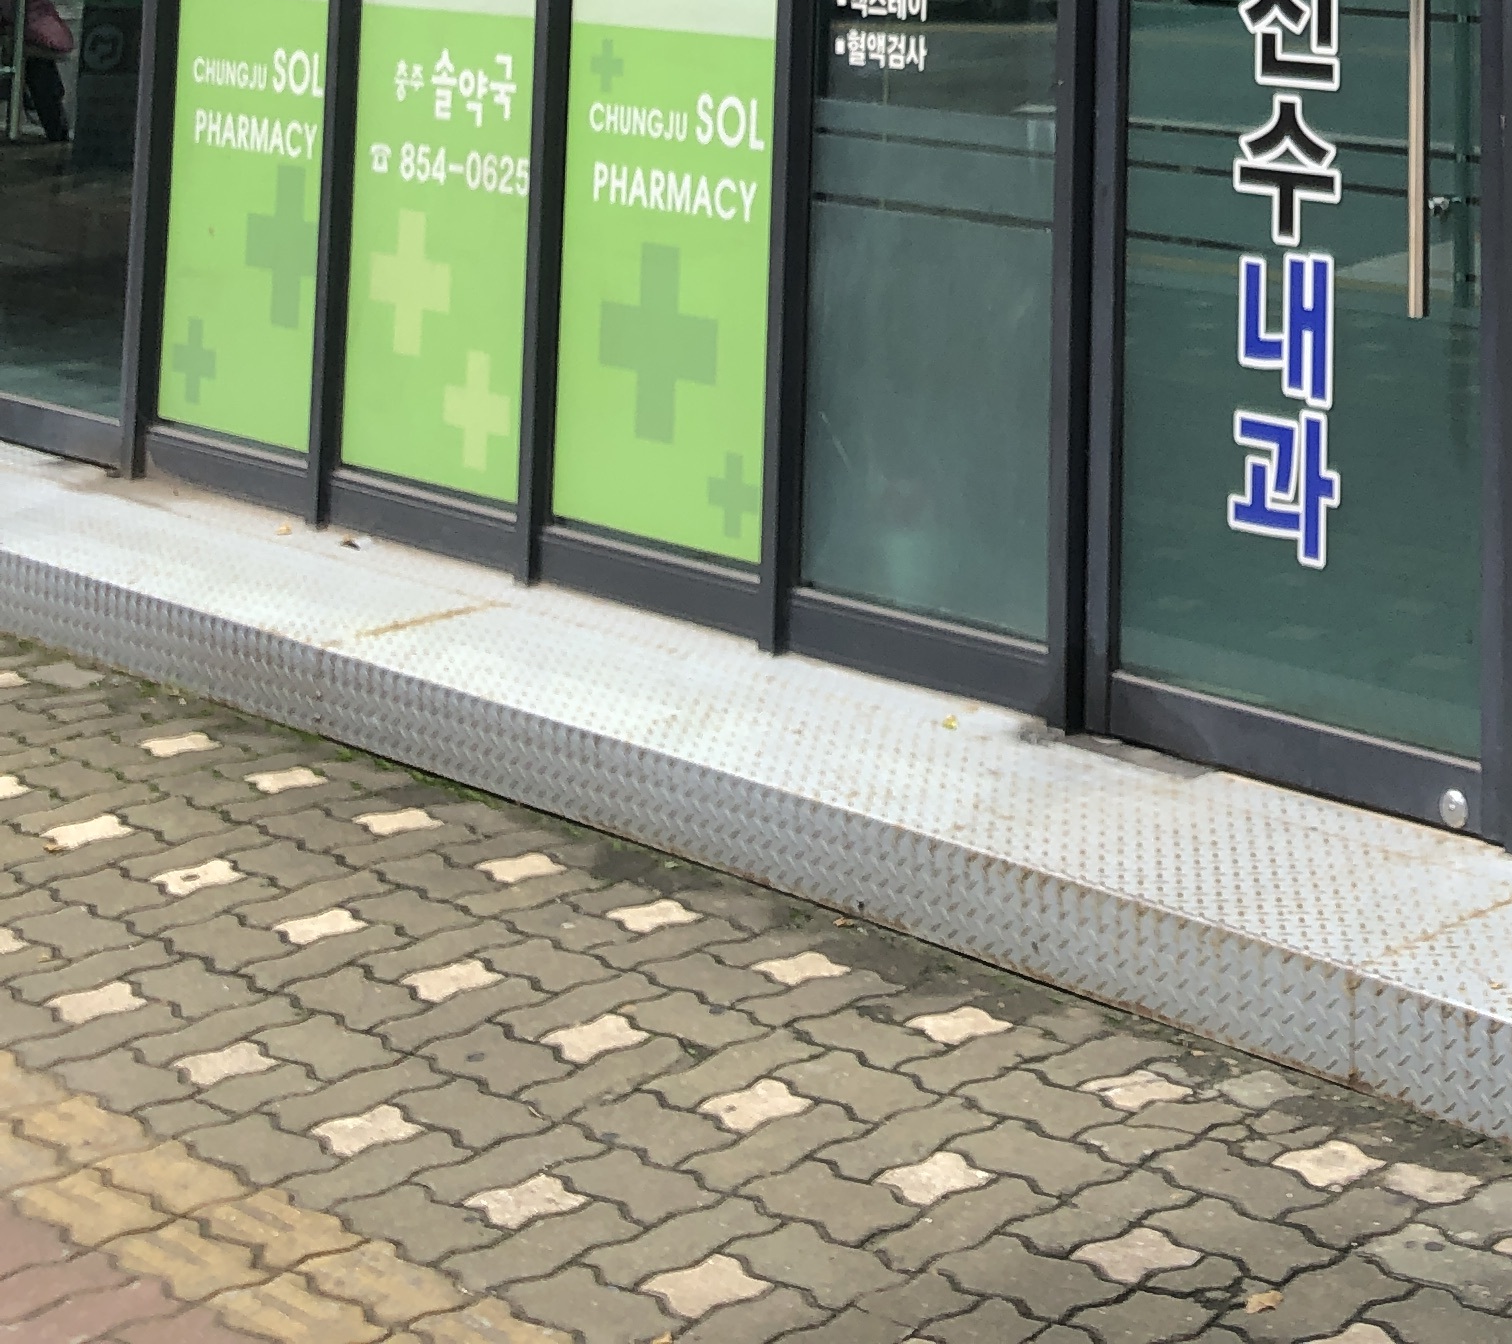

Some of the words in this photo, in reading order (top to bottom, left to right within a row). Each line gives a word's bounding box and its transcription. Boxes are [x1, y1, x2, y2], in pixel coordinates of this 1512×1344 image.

[193, 56, 268, 90] CHUNGJU
[272, 48, 324, 98] SOL
[846, 28, 928, 72] 혈액검사
[394, 59, 424, 102] 충주
[431, 48, 518, 128] 솔약국
[194, 108, 318, 160] PHARMACY
[589, 101, 688, 142] CHUNGJU
[695, 91, 765, 151] SOL
[400, 141, 531, 197] 854-0625
[593, 161, 757, 223] PHARMACY
